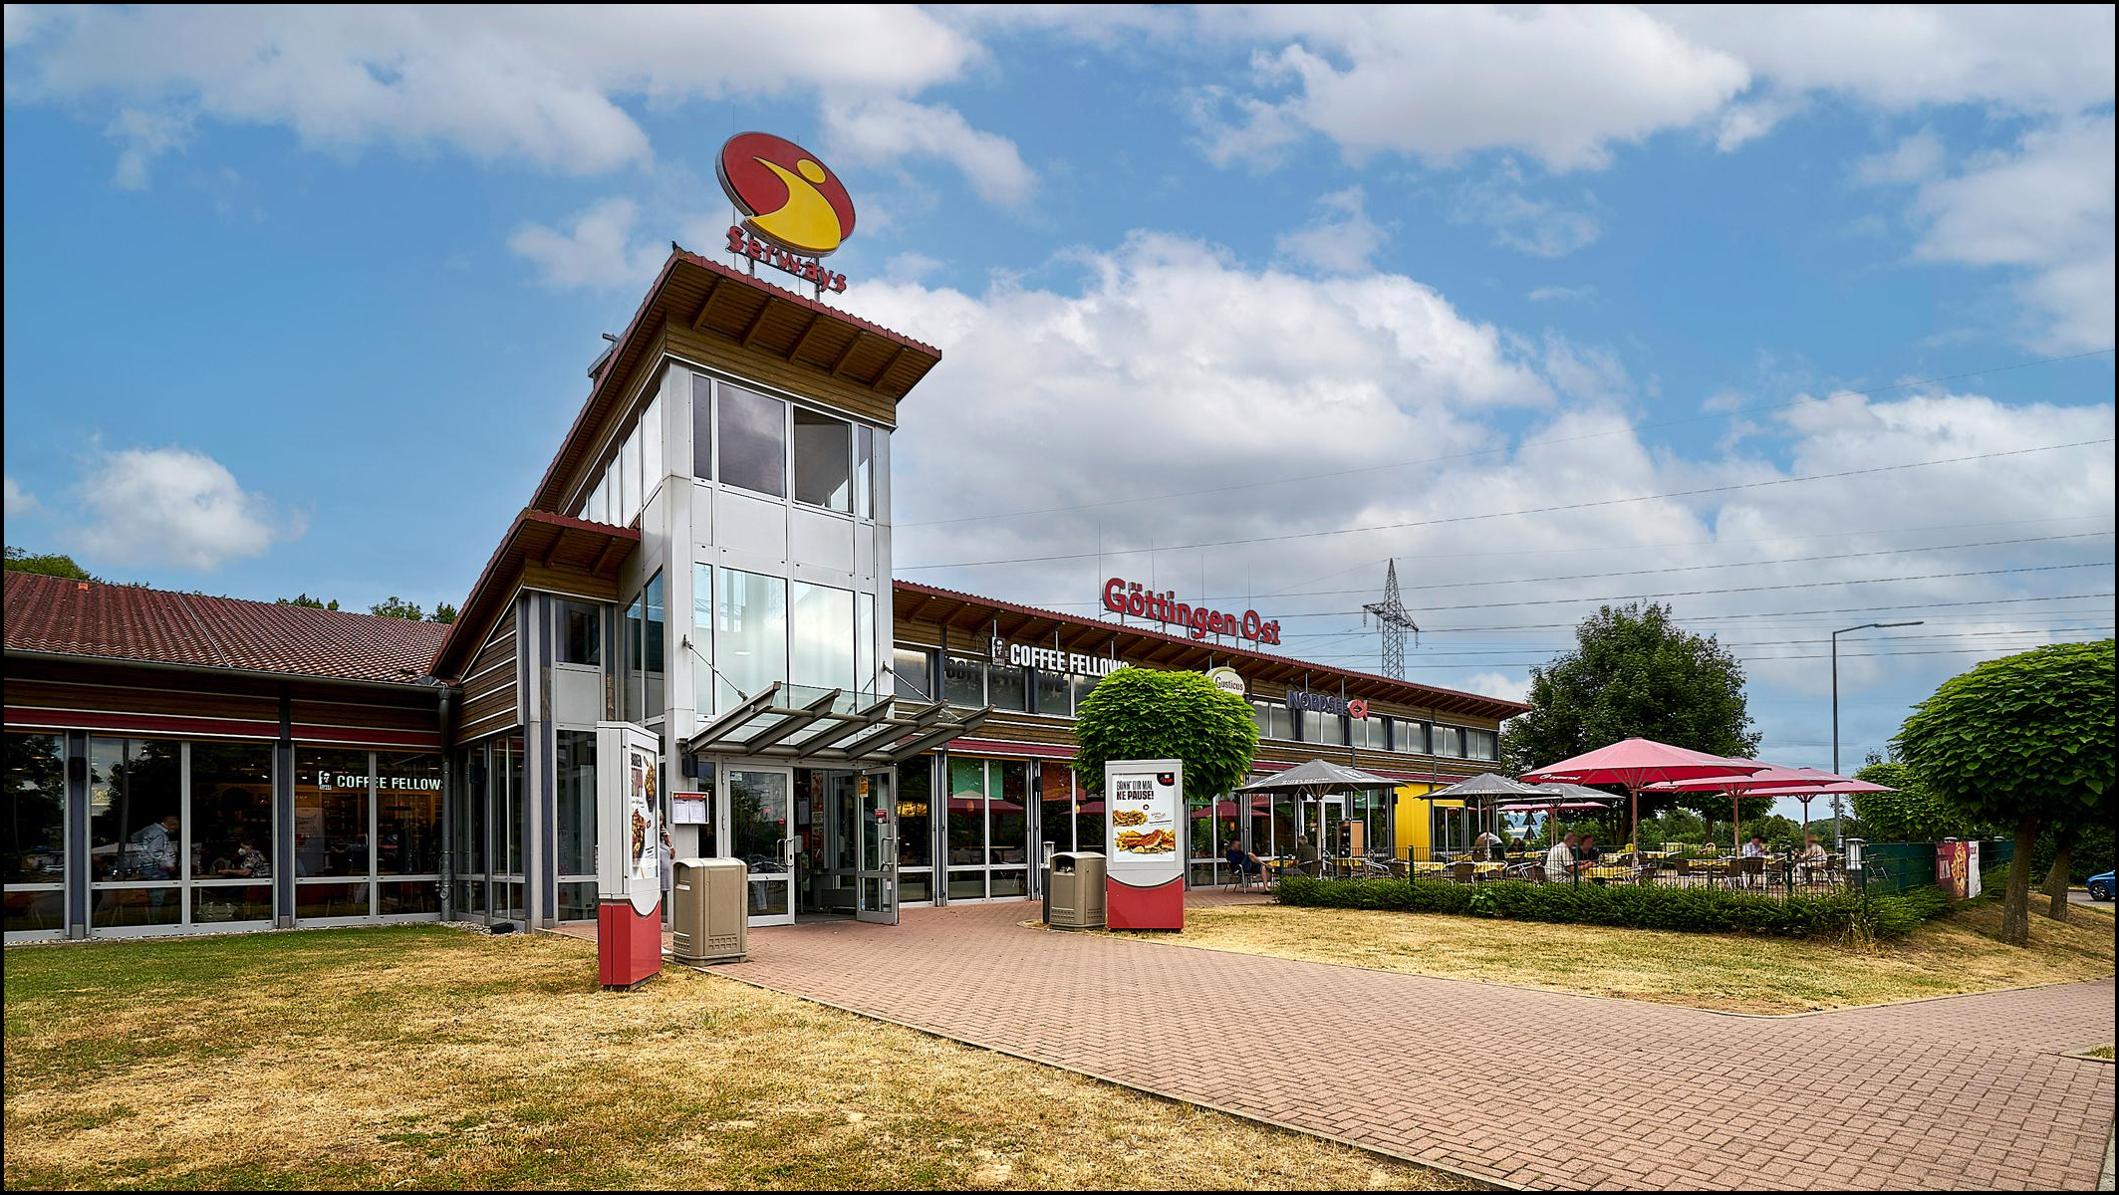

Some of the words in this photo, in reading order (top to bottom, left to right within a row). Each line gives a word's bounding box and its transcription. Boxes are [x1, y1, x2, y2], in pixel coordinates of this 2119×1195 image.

[726, 226, 847, 295] Serways
[1102, 577, 1236, 639] Göttingen
[1242, 609, 1280, 645] Ost
[1010, 643, 1066, 672] COFFEE
[1214, 676, 1244, 692] Gusticus
[1286, 689, 1350, 716] NORDSEE
[391, 776, 443, 790] FELLOW
[1116, 790, 1127, 801] NE
[1127, 790, 1155, 801] PAUSE!
